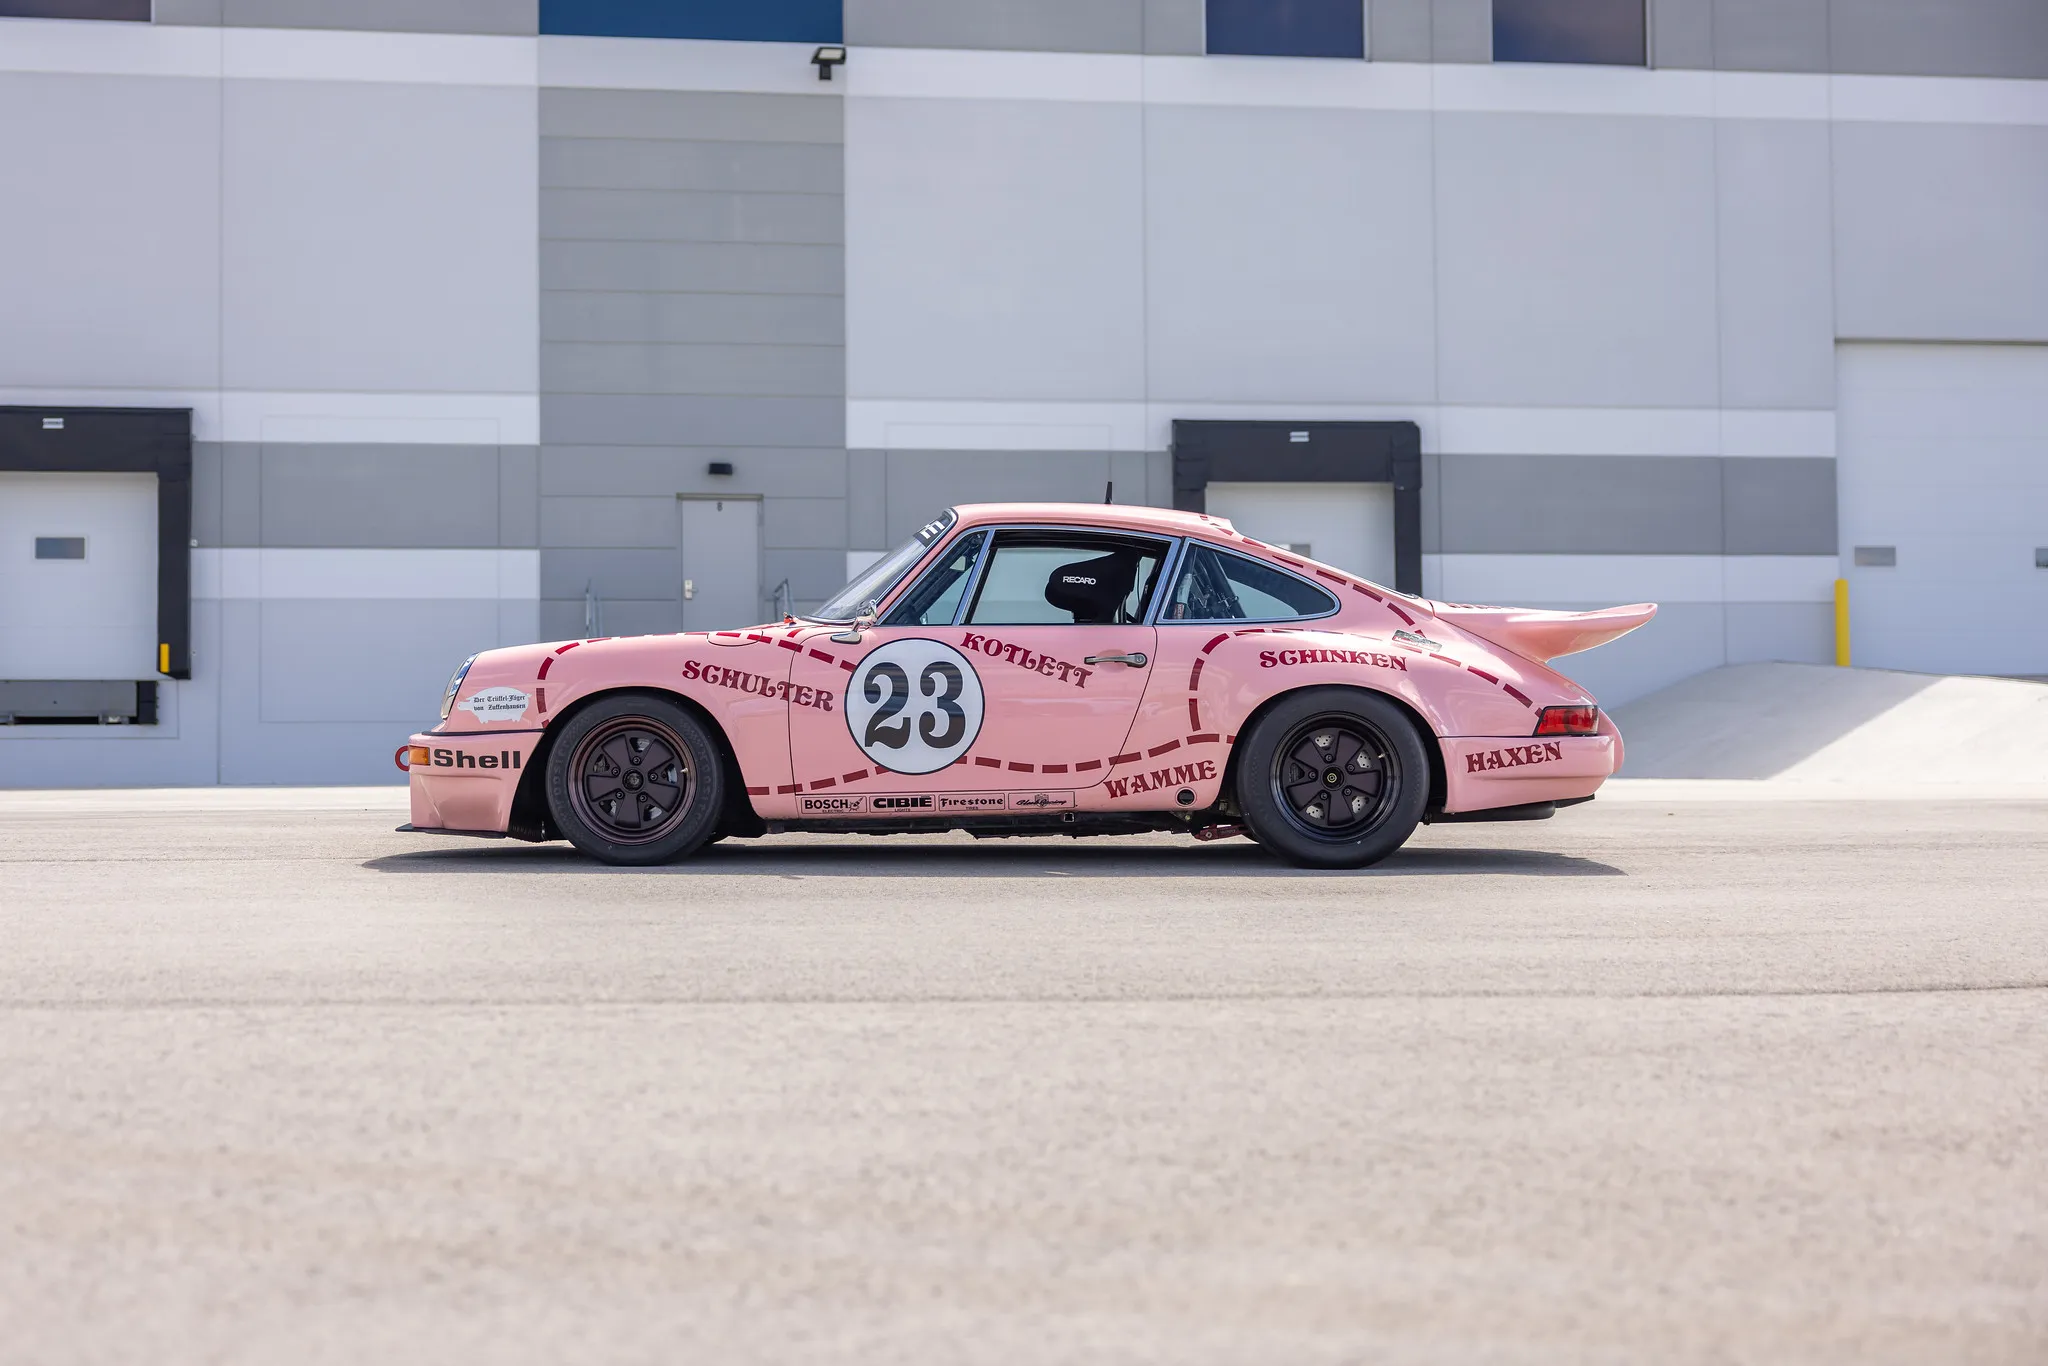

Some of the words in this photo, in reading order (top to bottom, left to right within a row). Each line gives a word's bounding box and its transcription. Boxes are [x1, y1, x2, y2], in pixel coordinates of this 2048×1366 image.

[1062, 575, 1097, 585] RECARO
[960, 632, 1093, 689] KOTLETT
[1259, 649, 1408, 672] SCHINKEN
[681, 659, 834, 712] SCHULTER
[864, 661, 966, 749] 23
[433, 748, 521, 769] Shell
[1465, 741, 1563, 774] HAXEN
[1103, 760, 1218, 799] WAMME
[804, 799, 849, 810] BOSCH
[940, 797, 1004, 808] Firestone
